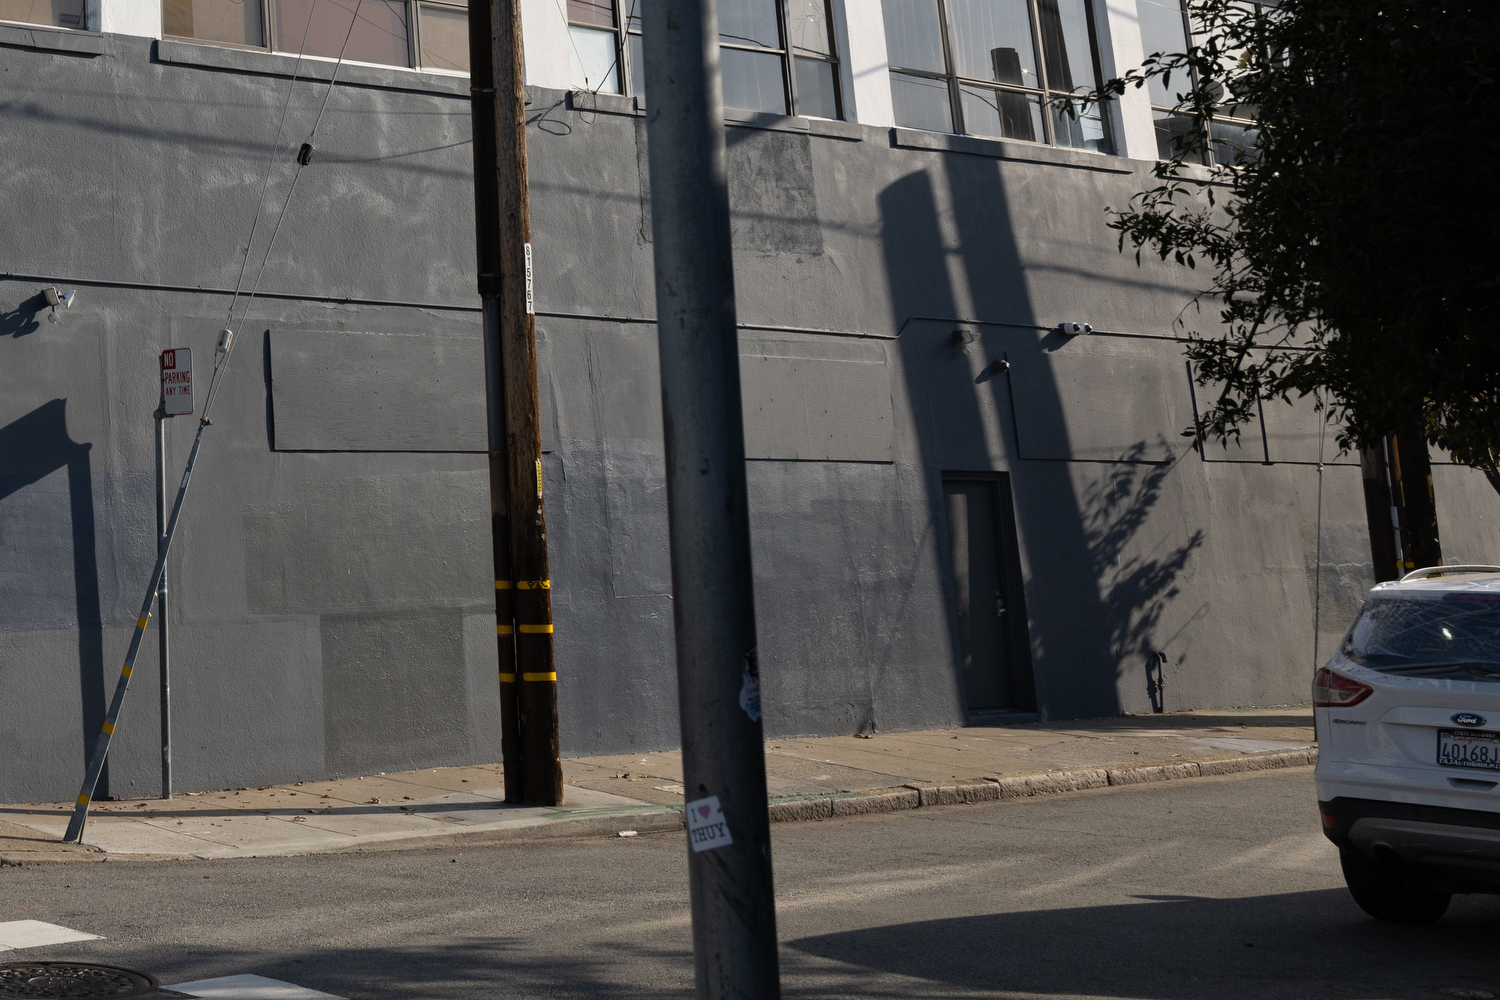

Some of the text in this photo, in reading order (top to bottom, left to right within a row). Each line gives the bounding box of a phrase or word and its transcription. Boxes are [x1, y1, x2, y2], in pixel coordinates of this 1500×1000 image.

[163, 352, 174, 367] NO
[164, 370, 190, 384] PARKING
[165, 385, 190, 396] ANY TIME
[1457, 715, 1477, 724] Ford
[1442, 743, 1500, 763] 40168J
[691, 808, 698, 822] I
[692, 822, 725, 843] THUY
